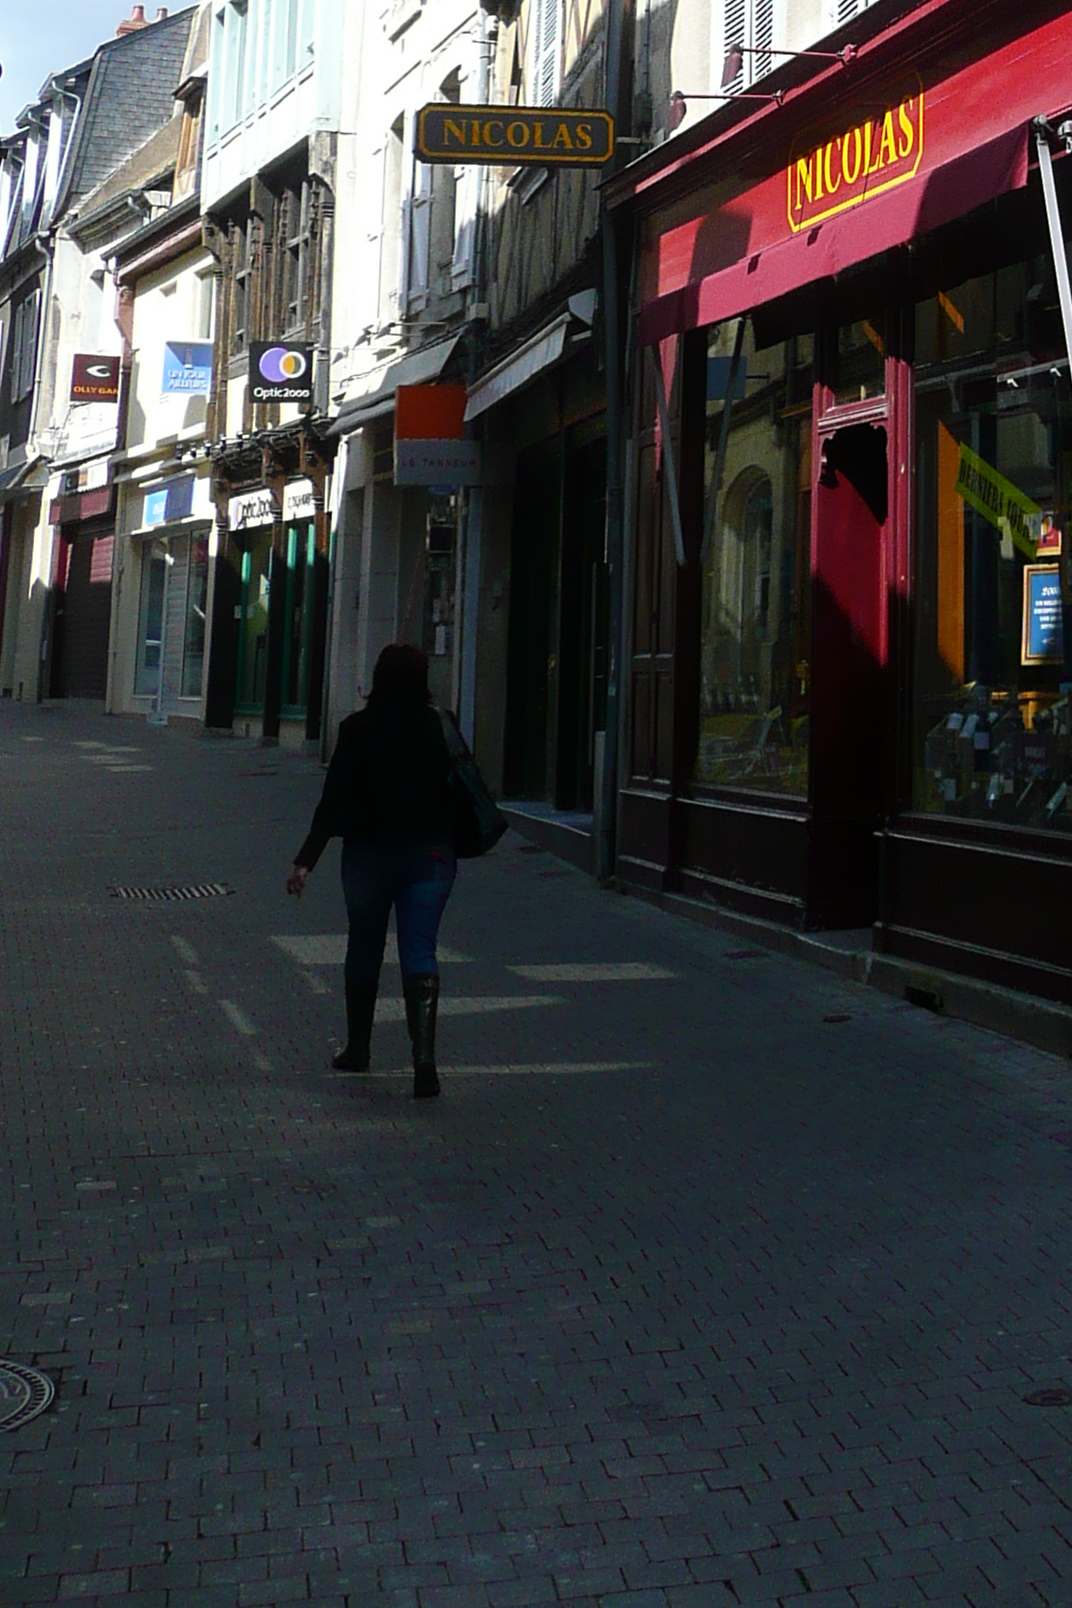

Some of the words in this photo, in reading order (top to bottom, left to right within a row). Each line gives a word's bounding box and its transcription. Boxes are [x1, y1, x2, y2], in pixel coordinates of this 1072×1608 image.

[443, 118, 592, 150] NICOLAS
[795, 94, 915, 211] NICOLAS
[253, 386, 311, 401] Optic2000
[422, 458, 477, 469] TANNEUR
